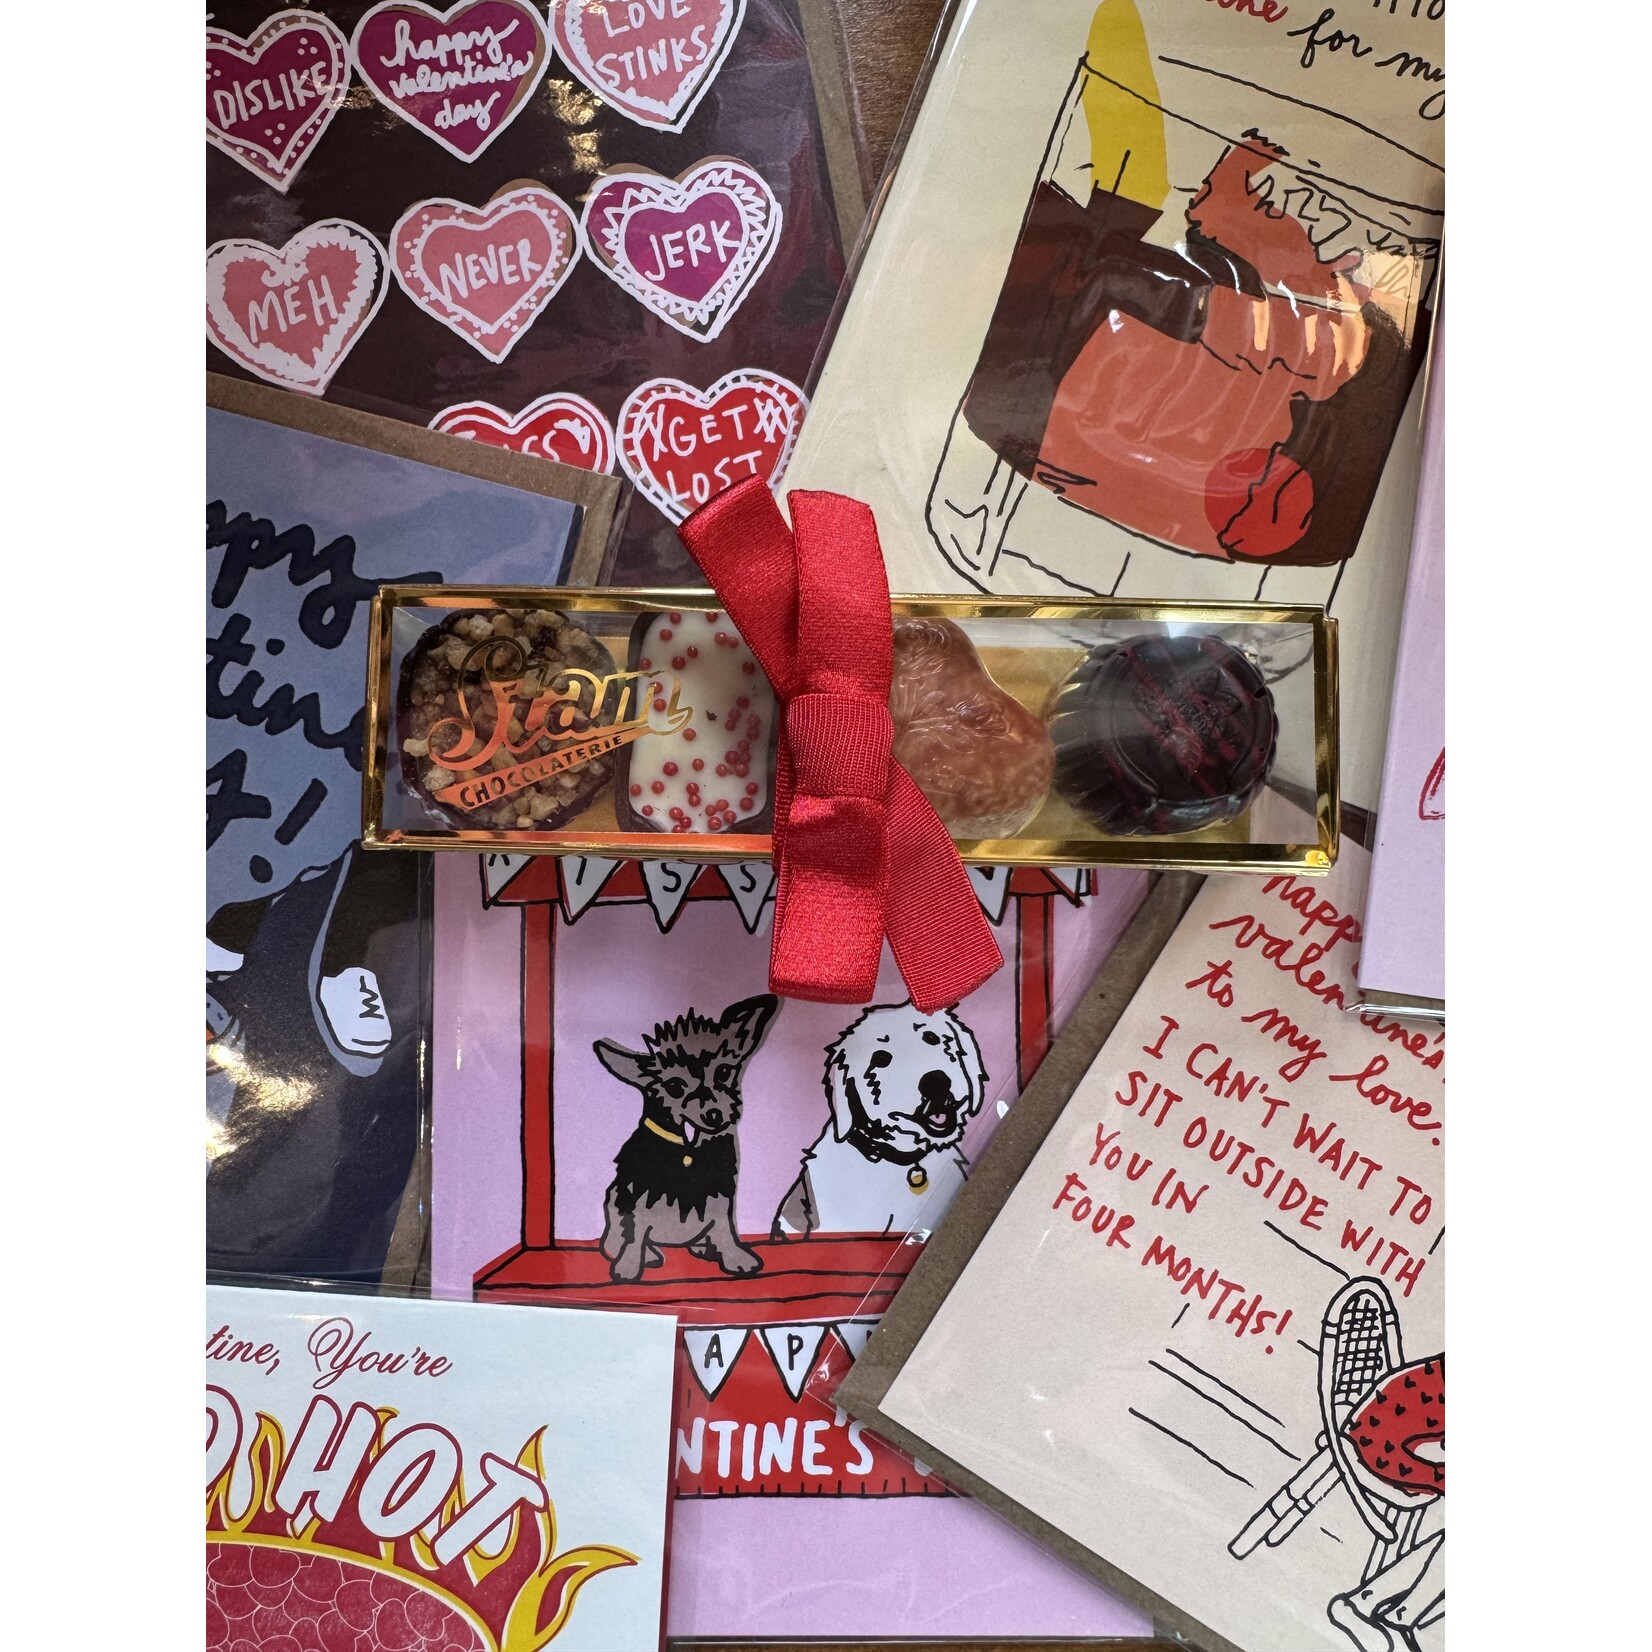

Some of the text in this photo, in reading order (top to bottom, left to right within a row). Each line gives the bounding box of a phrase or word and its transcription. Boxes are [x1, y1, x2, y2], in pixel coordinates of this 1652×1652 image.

[380, 19, 519, 67] happy
[596, 25, 708, 87] STINKS
[1287, 8, 1373, 68] for
[213, 61, 329, 129] DISLIKE
[434, 91, 501, 131] day
[439, 239, 542, 299] NEVER
[645, 220, 741, 281] JERK
[249, 275, 339, 343] MEH
[669, 405, 749, 457] GET
[666, 449, 763, 504] LOST
[459, 735, 623, 808] CHOCOLATERIE
[1185, 959, 1443, 1147] to my love.
[1142, 1015, 1432, 1225] I CAN'T WAIT TO
[1089, 1122, 1210, 1214] YOU IN
[1115, 1070, 1426, 1297] SIT OUTSIDE WITH
[1052, 1172, 1293, 1355] FOUR MONTHS!
[307, 1317, 453, 1390] You're
[274, 1394, 549, 1567] HOT
